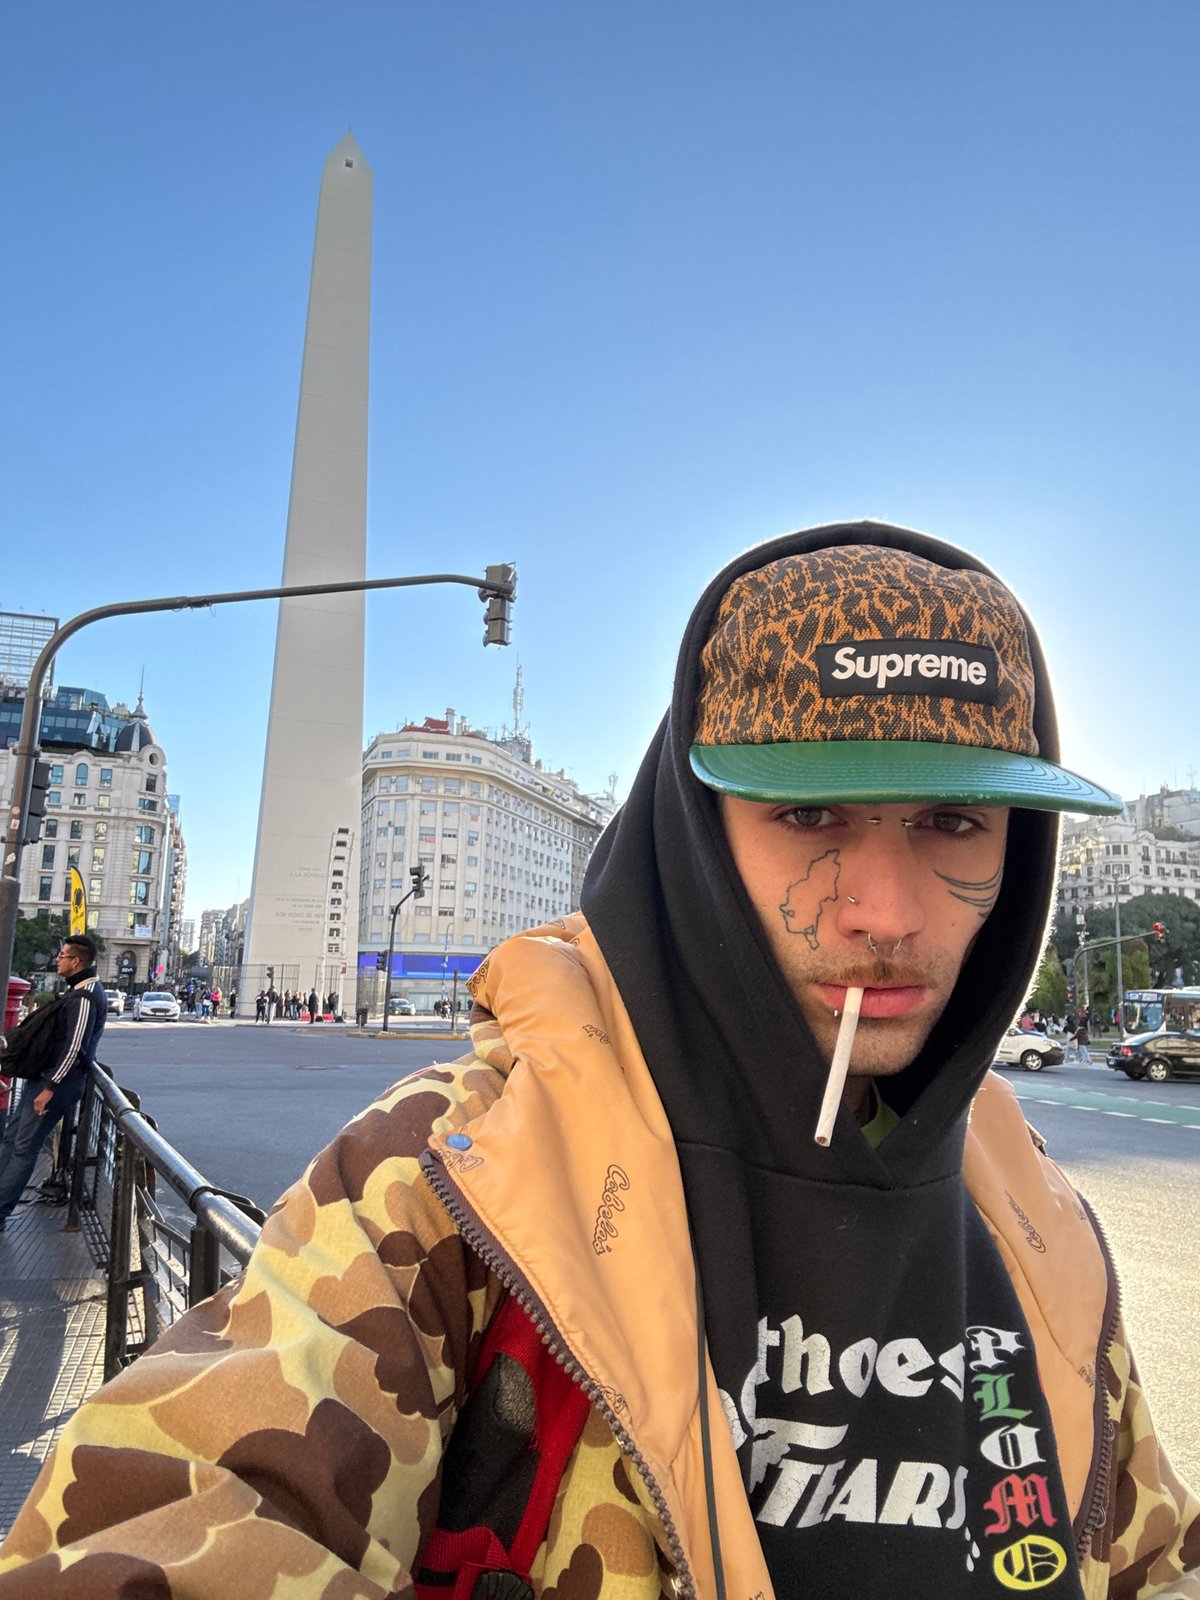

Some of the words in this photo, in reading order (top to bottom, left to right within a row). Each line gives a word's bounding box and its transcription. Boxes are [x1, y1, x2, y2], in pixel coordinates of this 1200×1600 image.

[832, 647, 987, 688] Supreme
[593, 1164, 630, 1256] Cabela's
[965, 1325, 1068, 1591] PLOMO
